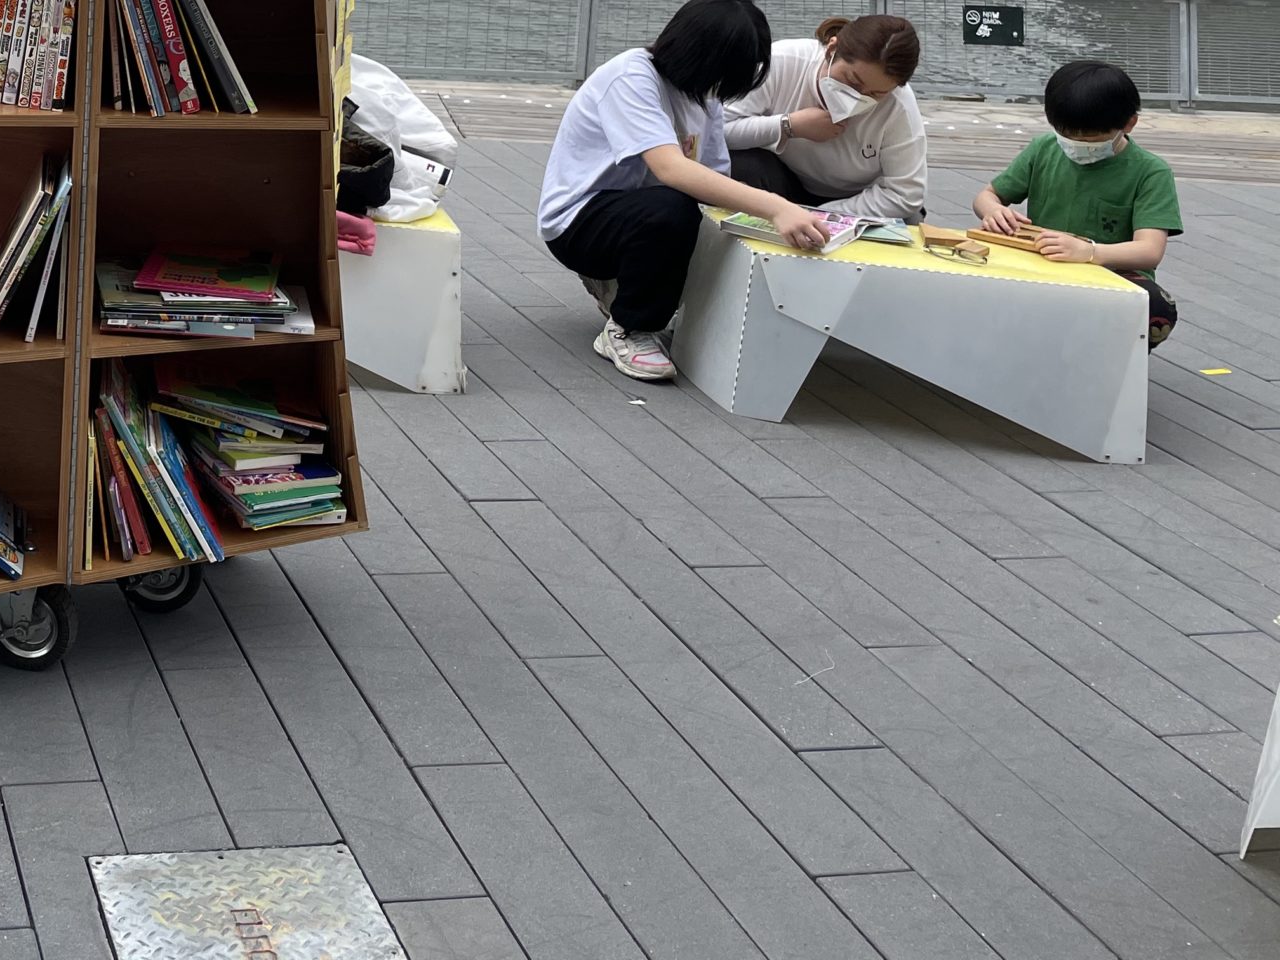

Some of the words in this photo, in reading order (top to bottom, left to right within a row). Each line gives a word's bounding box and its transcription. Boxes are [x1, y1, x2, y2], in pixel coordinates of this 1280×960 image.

[188, 2, 197, 11] of
[193, 11, 209, 38] Imperial
[206, 38, 219, 58] China
